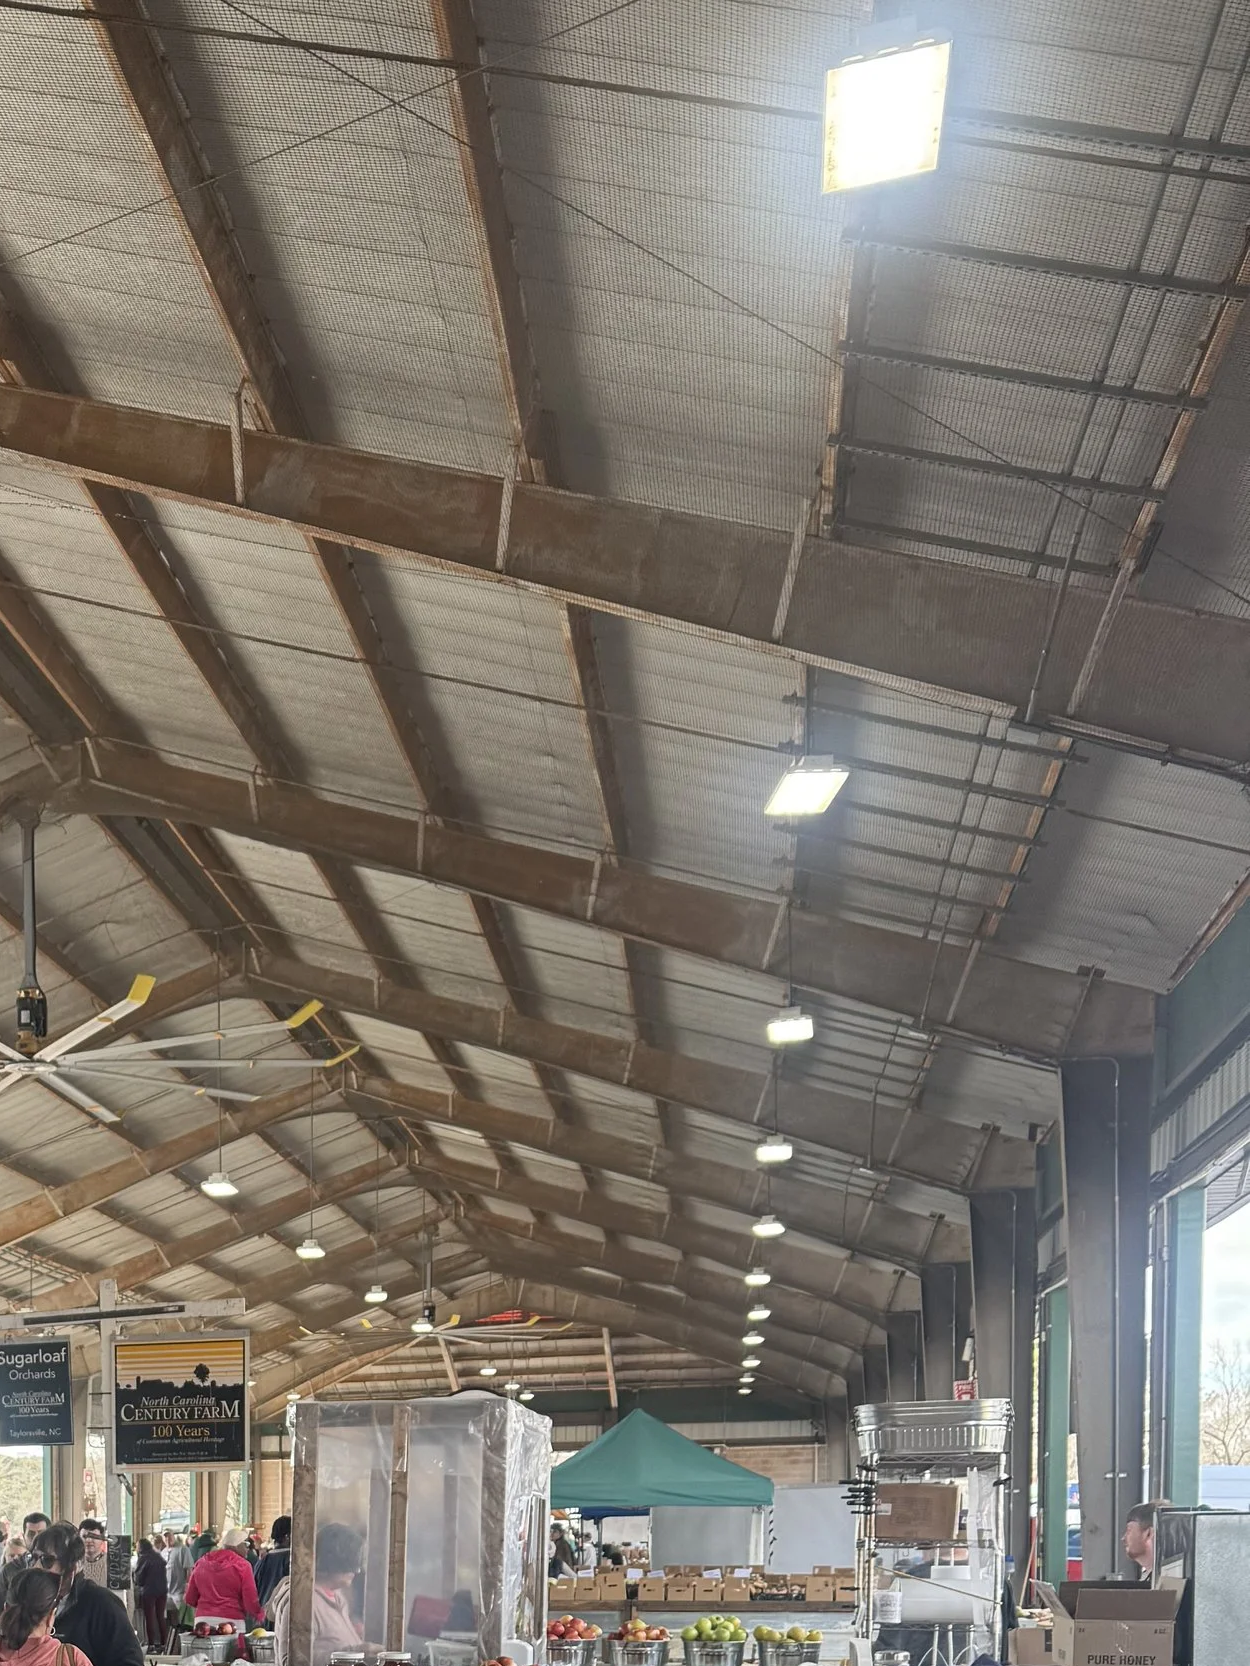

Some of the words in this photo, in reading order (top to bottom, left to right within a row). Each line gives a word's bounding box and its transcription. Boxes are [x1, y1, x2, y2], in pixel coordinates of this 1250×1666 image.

[8, 1368, 56, 1381] Orchards
[1, 1394, 40, 1406] CENTURY
[41, 1392, 65, 1404] FARM
[140, 1395, 169, 1406] North
[172, 1394, 216, 1406] Carolina
[18, 1406, 30, 1414] 100
[120, 1403, 191, 1421] CENTURY
[194, 1399, 241, 1419] FARM
[49, 1427, 62, 1436] NC
[152, 1425, 172, 1437] 100
[176, 1424, 210, 1437] Years
[1087, 1654, 1117, 1665] PURE
[1119, 1655, 1156, 1666] HONEY
